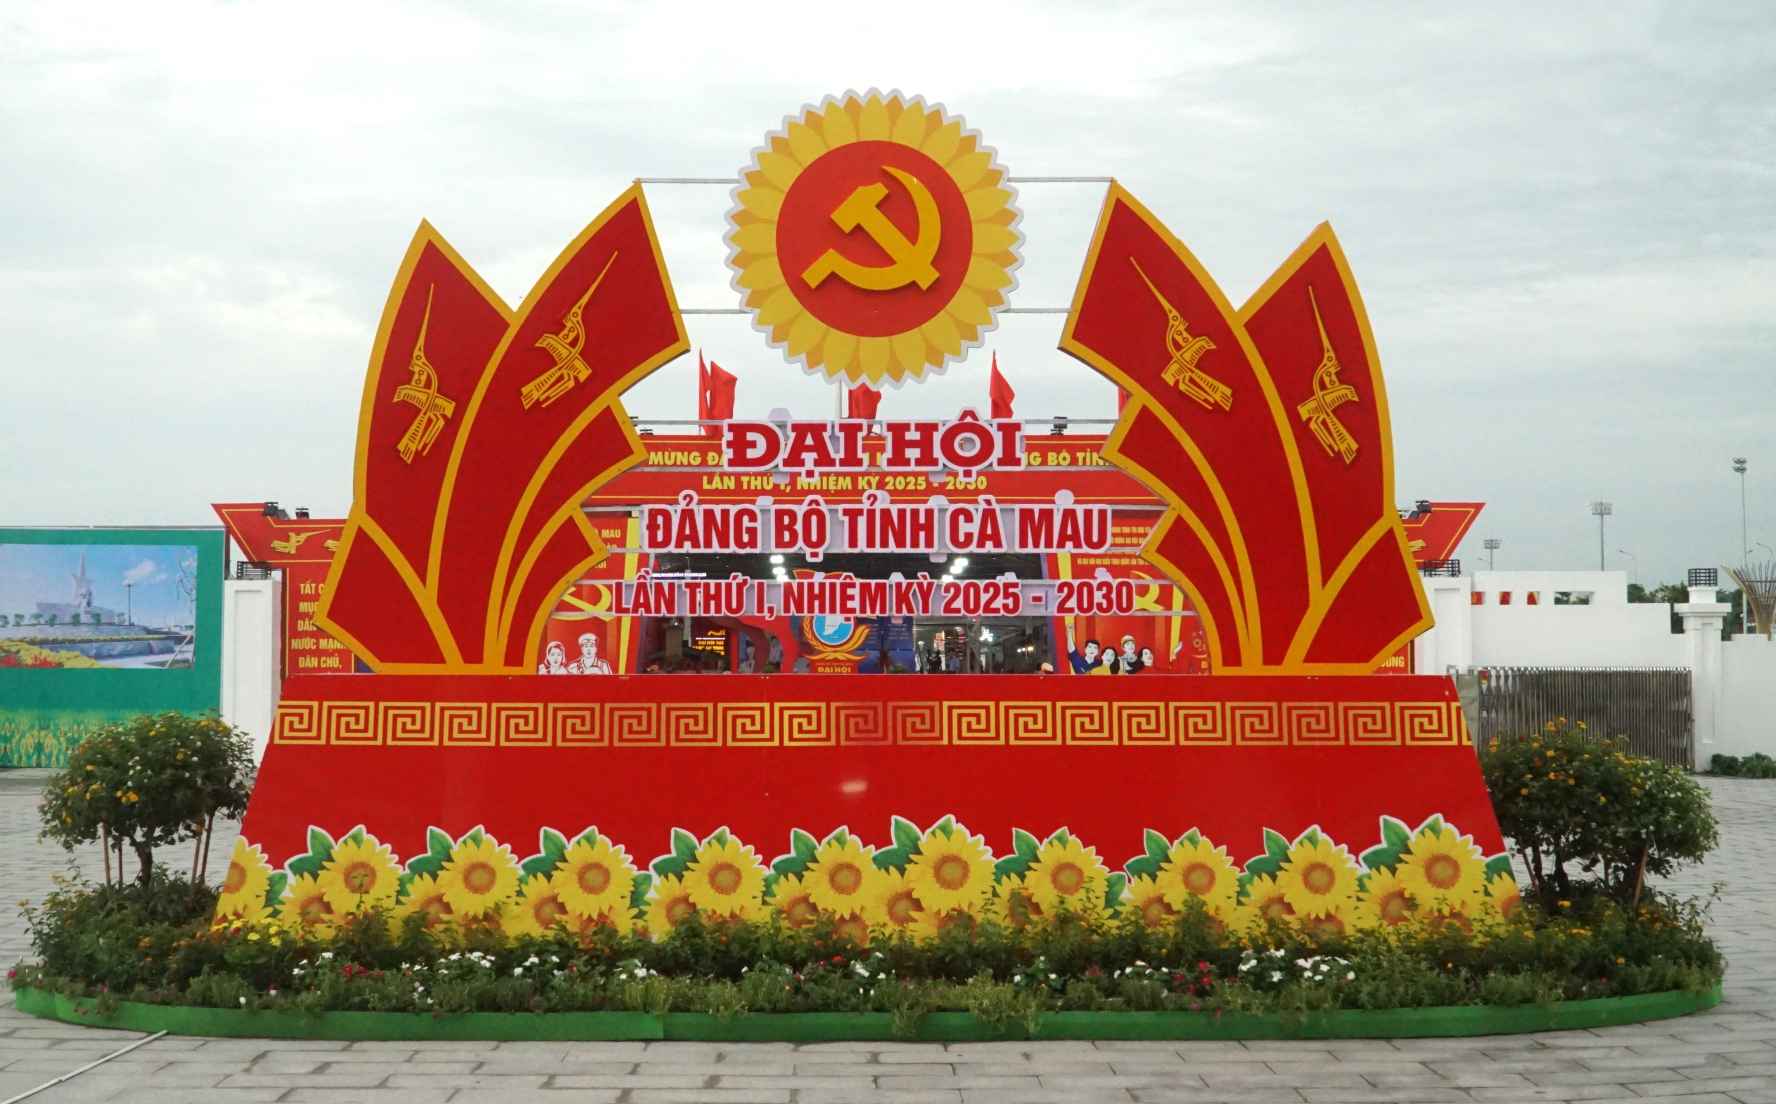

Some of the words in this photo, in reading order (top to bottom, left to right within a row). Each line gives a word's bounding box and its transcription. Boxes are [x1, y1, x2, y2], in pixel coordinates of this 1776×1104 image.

[725, 421, 865, 479] ĐẠI
[885, 409, 1022, 479] HỘI
[885, 475, 927, 490] 2025
[646, 493, 758, 550] ĐẢNG
[773, 497, 828, 558] BỘ
[842, 493, 936, 550] TỈNH
[948, 496, 1003, 550] CÀ
[1018, 508, 1110, 550] MAU
[613, 568, 676, 615] LẦN
[683, 573, 749, 615] THỨ
[756, 581, 776, 619] I,
[781, 574, 888, 622] NHIỆM
[894, 572, 936, 615] KỲ
[942, 581, 1021, 615] 2025
[1030, 594, 1043, 603] -
[1056, 581, 1135, 615] 2030
